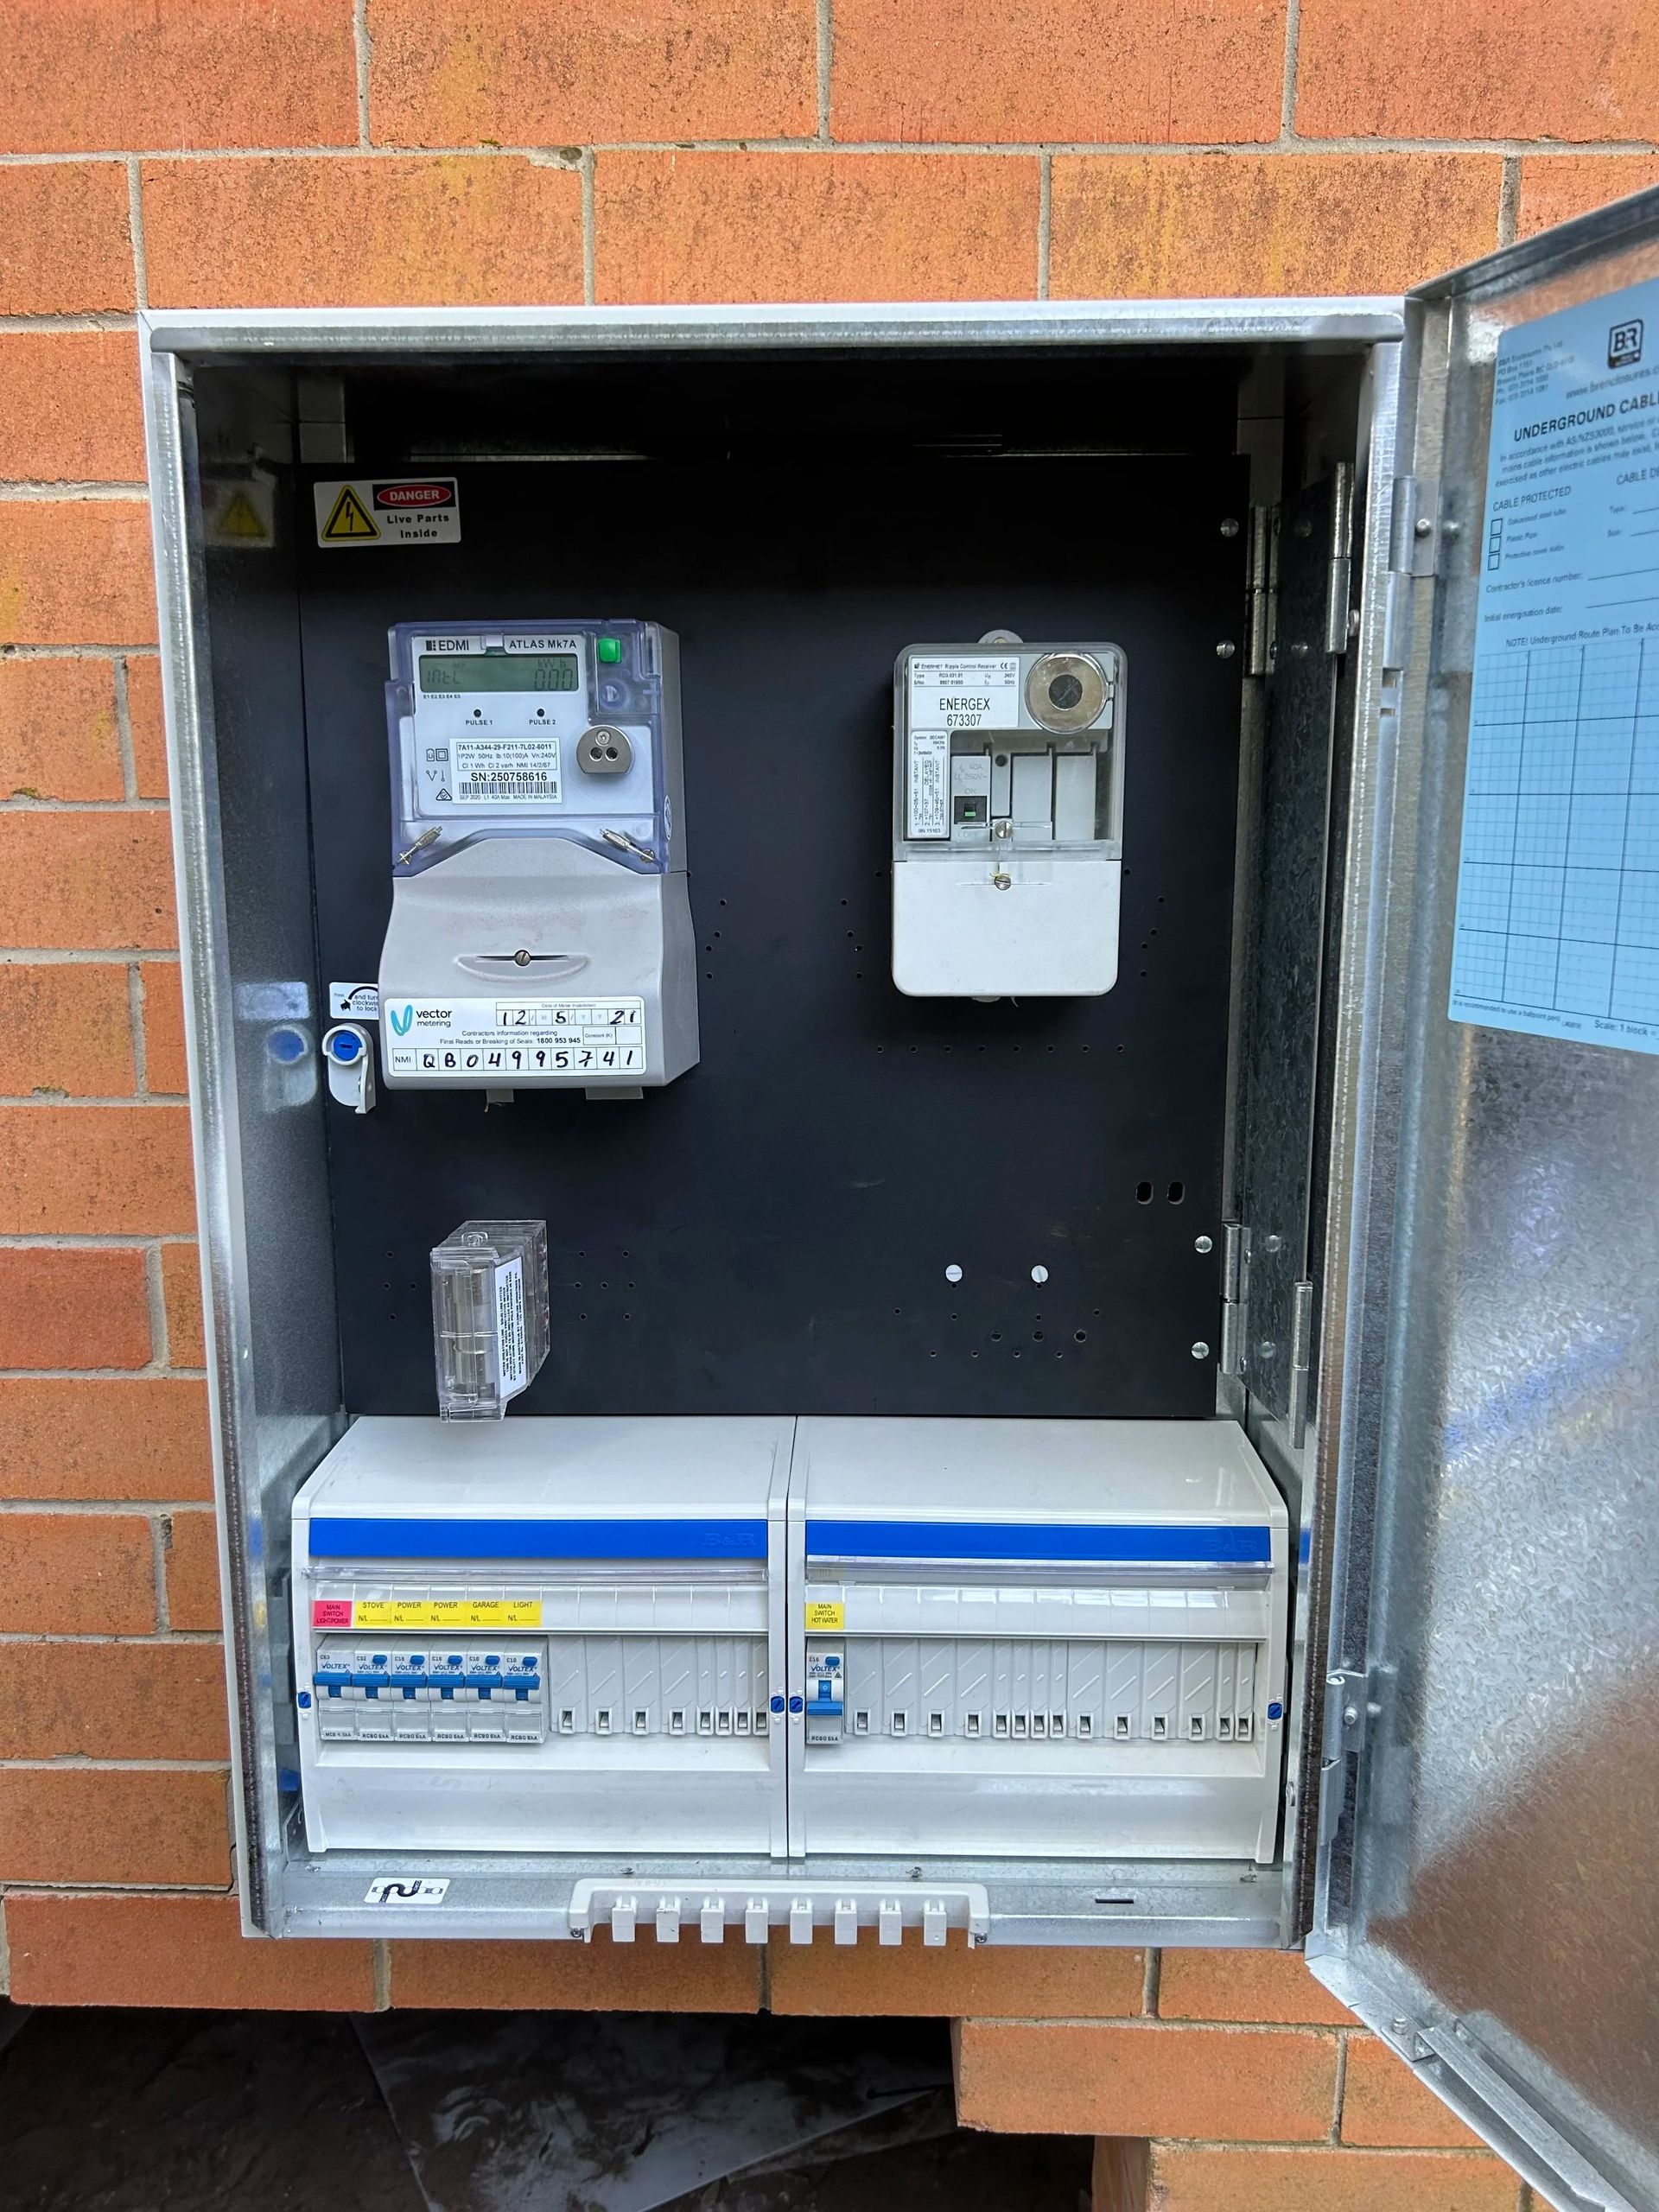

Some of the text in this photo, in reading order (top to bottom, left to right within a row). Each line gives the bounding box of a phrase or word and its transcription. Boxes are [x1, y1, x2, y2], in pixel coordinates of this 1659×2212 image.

[1514, 404, 1616, 442] UNDERGROUND
[1619, 391, 1659, 413] CABL
[1508, 445, 1548, 461] accordance
[1549, 441, 1564, 449] with
[1523, 459, 1542, 469] cable
[1545, 448, 1584, 463] information
[1594, 439, 1619, 451] shown
[1496, 473, 1528, 487] exercised
[1539, 467, 1557, 477] other
[1559, 461, 1585, 473] electric
[1586, 454, 1611, 466] cables
[1617, 469, 1646, 485] CABLE
[390, 490, 440, 501] DANGER
[1492, 486, 1571, 512] CABLE PROTECTED
[387, 513, 449, 524] Live Parts
[400, 530, 438, 538] Inside
[1485, 577, 1525, 594] Contractor's
[1527, 576, 1551, 587] licence
[1484, 613, 1501, 622] Initial
[1503, 608, 1544, 621] energisation
[1530, 632, 1576, 645] Underground
[1579, 630, 1600, 640] Route
[1602, 627, 1618, 637] Plan
[1621, 626, 1630, 634] To
[1633, 624, 1643, 632] Be
[438, 640, 469, 651] EDMI
[510, 639, 576, 649] ATLAS Mk7A
[939, 697, 990, 710] ENERGEX
[946, 714, 982, 727] 673307
[471, 772, 547, 782] SN:250758616
[416, 1009, 453, 1019] vector
[555, 1011, 567, 1024] 5
[1626, 1026, 1648, 1036] block
